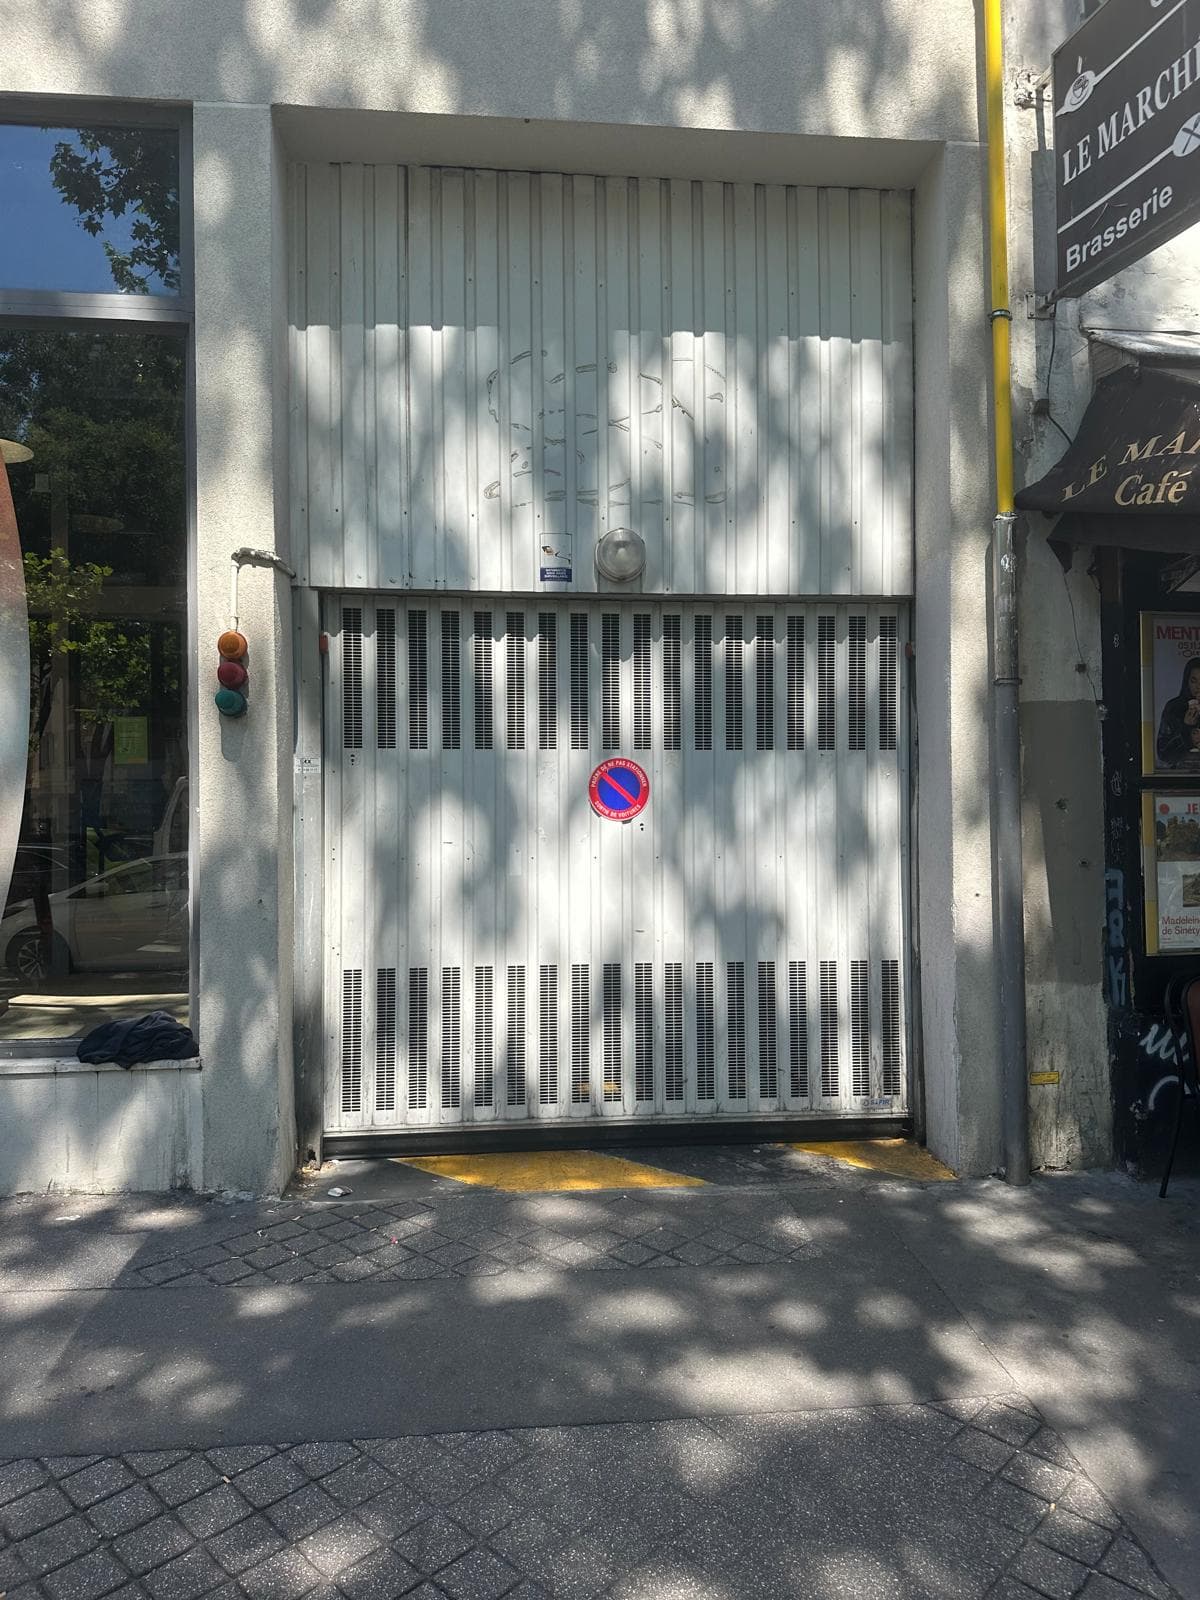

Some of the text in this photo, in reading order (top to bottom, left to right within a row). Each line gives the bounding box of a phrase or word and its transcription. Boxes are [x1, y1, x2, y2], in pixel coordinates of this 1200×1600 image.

[1062, 134, 1092, 187] LE
[1066, 185, 1173, 273] Brasserie
[1061, 455, 1108, 502] LE
[1114, 470, 1193, 506] Café
[1185, 803, 1200, 815] JE
[1162, 915, 1200, 926] Madelein
[1162, 926, 1173, 936] de
